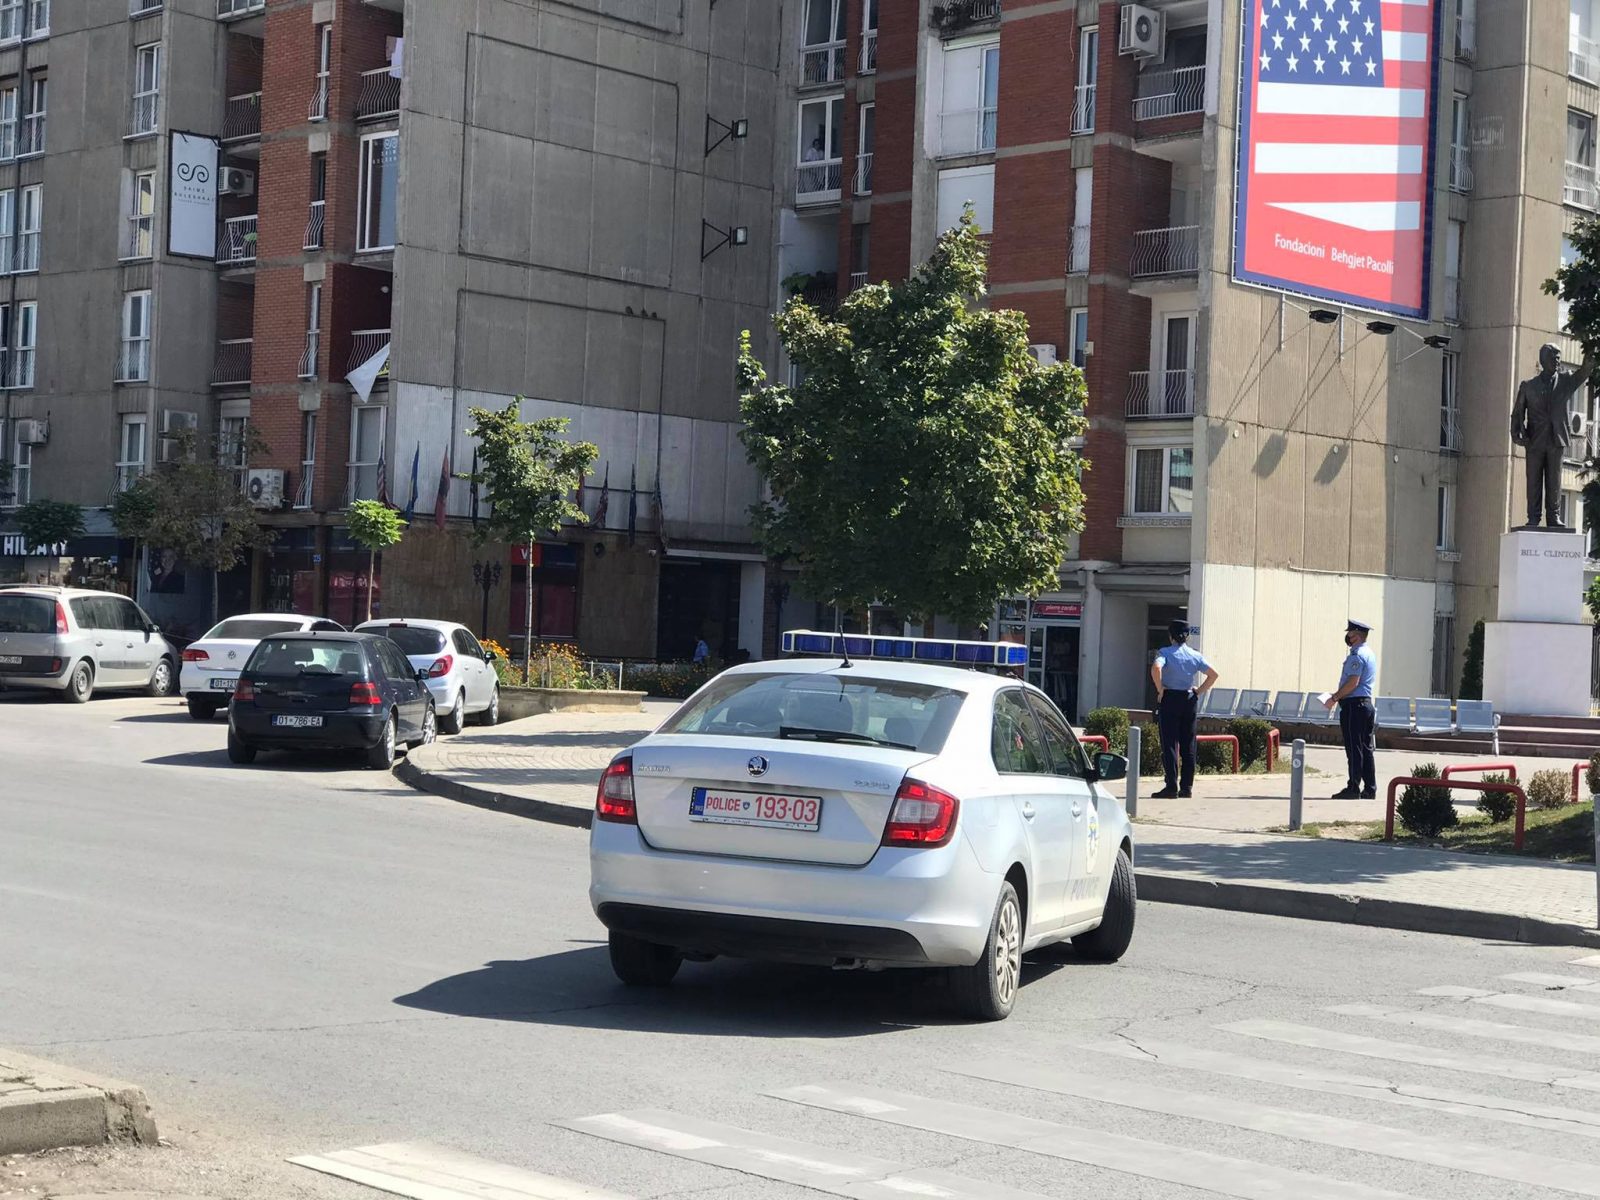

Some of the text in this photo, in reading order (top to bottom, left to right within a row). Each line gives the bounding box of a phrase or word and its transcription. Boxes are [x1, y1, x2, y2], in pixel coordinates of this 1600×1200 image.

[1274, 233, 1394, 275] Fondacioni Behgjet Pacolli
[3, 535, 68, 556] HILAY
[1520, 549, 1581, 559] BILL CLINTON
[706, 796, 741, 812] POLICE
